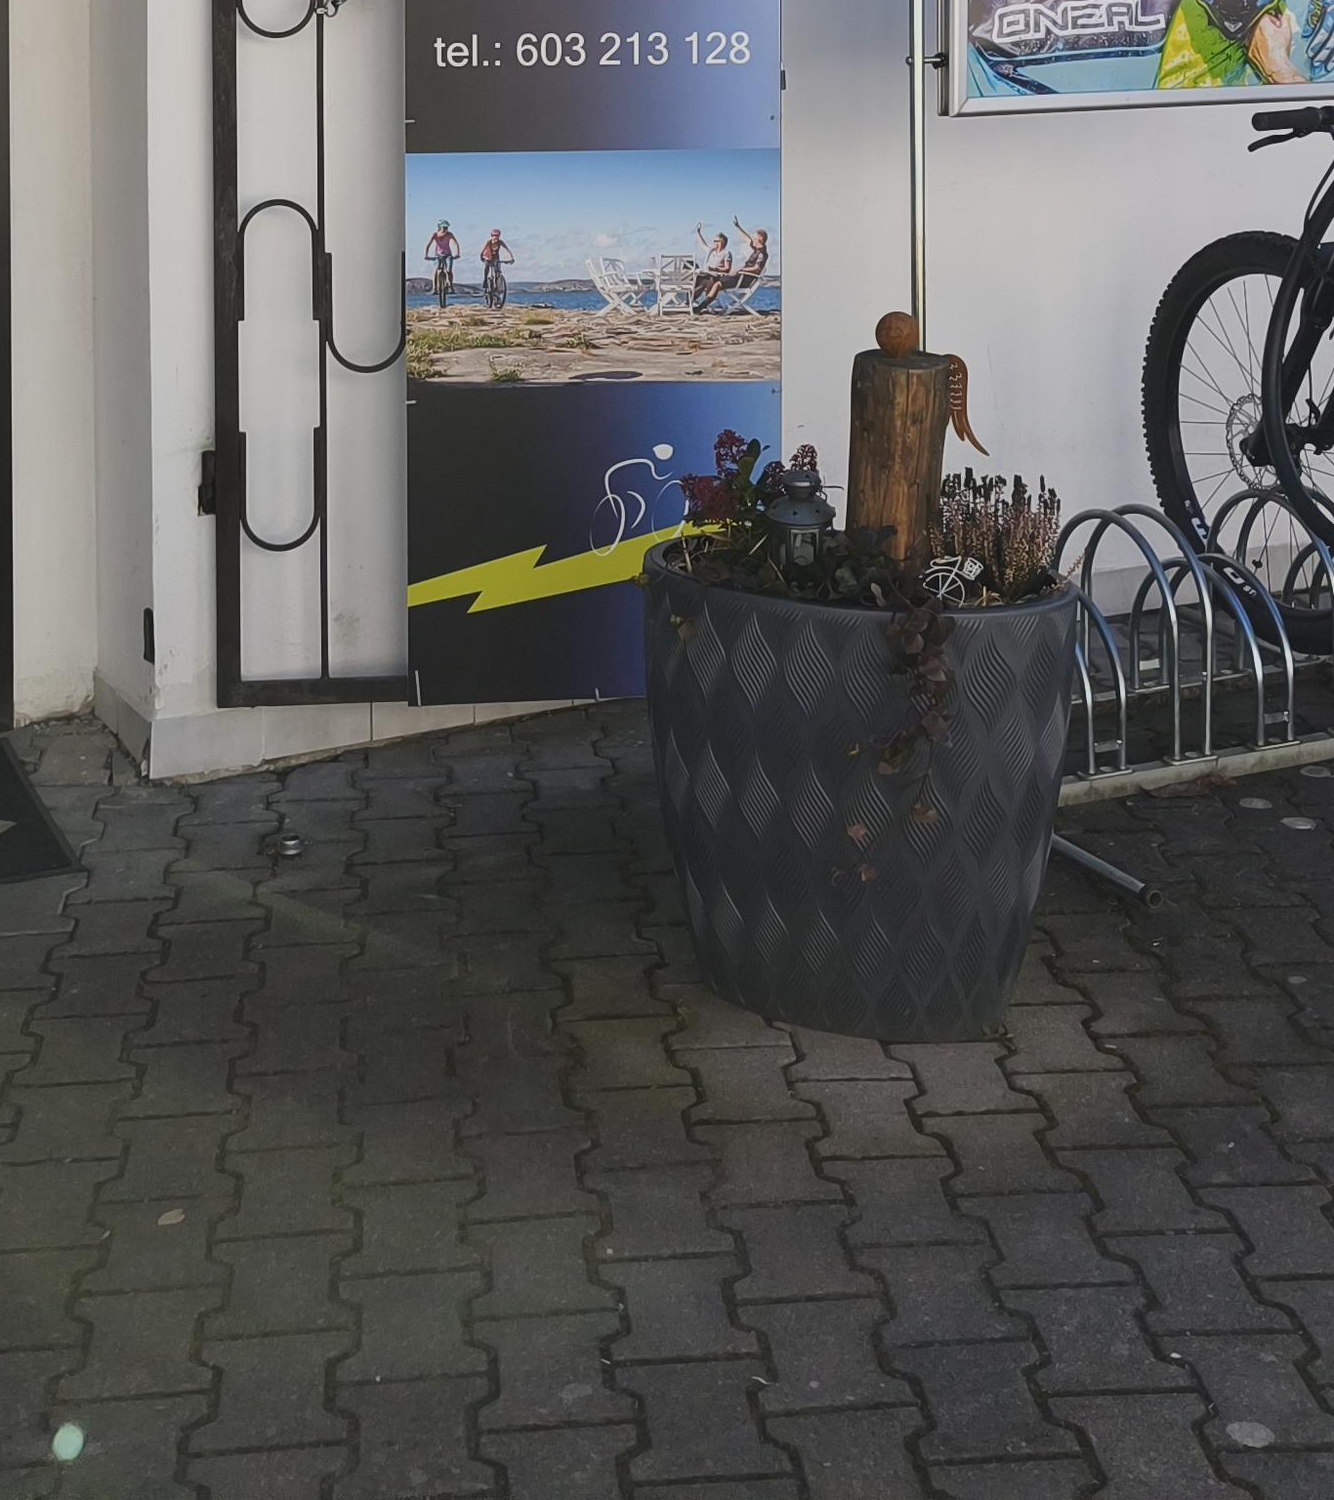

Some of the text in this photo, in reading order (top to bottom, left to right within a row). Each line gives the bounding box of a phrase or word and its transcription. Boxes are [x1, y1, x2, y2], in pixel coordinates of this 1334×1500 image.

[434, 31, 751, 67] tel.: 603 213 128
